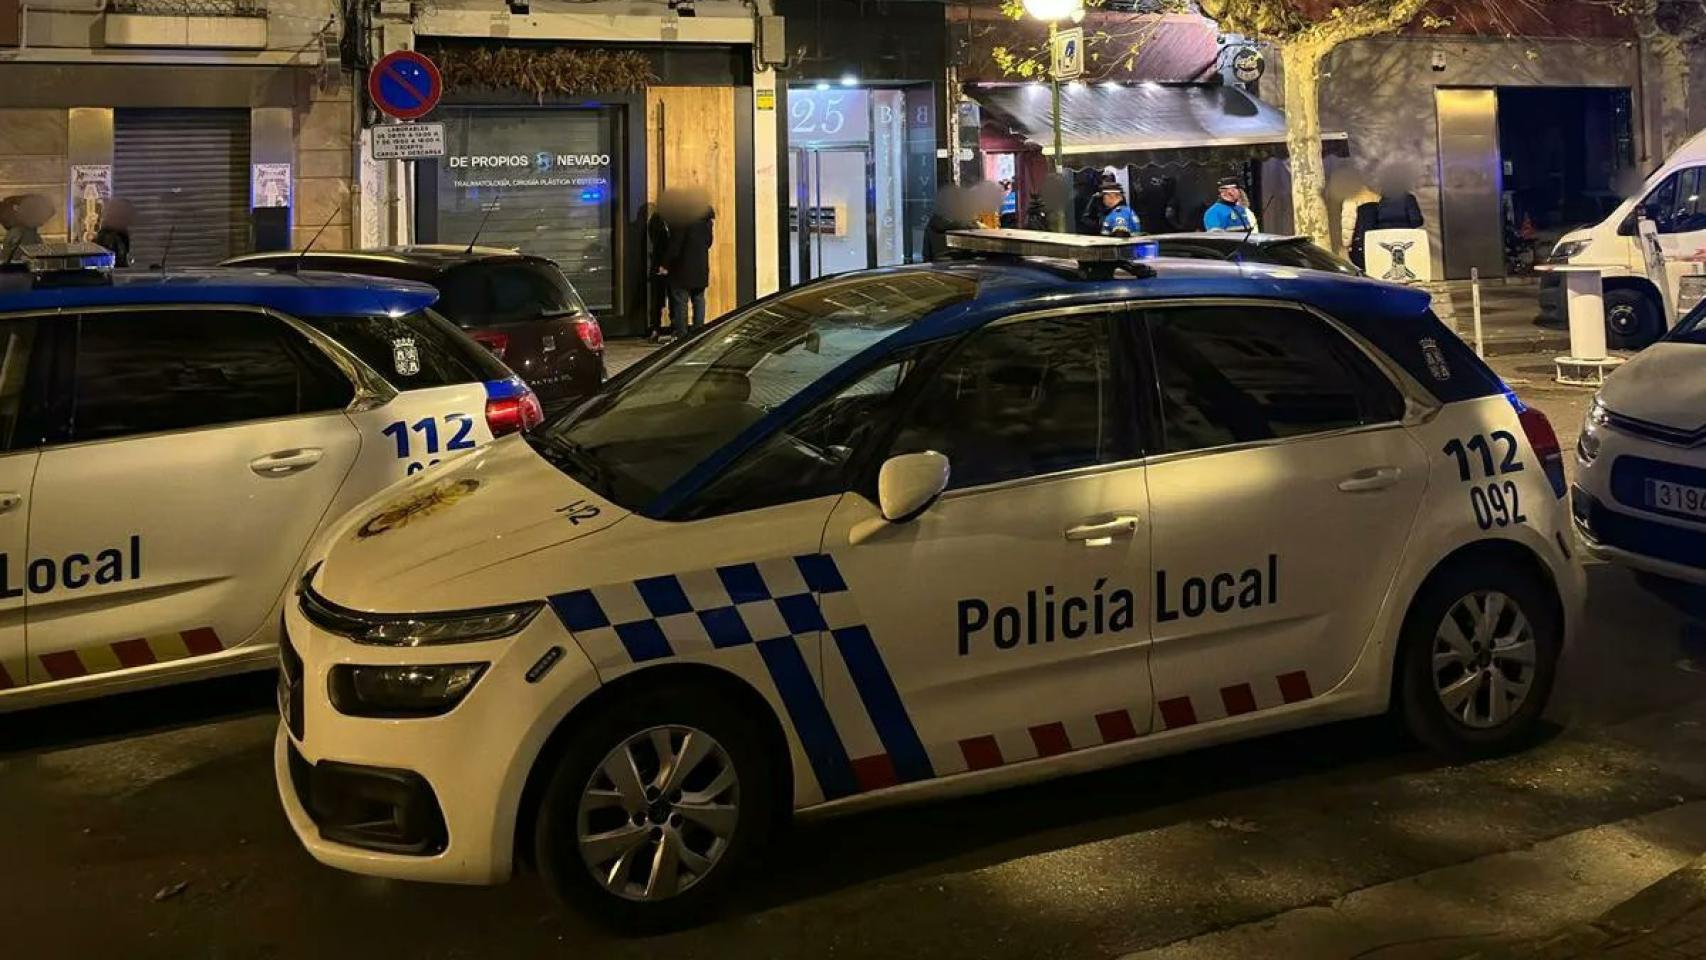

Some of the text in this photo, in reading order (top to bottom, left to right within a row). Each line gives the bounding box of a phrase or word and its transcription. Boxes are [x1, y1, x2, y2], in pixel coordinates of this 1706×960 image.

[791, 95, 845, 134] 25
[450, 154, 610, 168] DE PROPIOS NEVADO
[381, 413, 476, 459] 112
[1442, 430, 1525, 482] 112
[1470, 480, 1526, 531] 092
[0, 535, 140, 599] Local
[957, 553, 1278, 656] Policía Local
